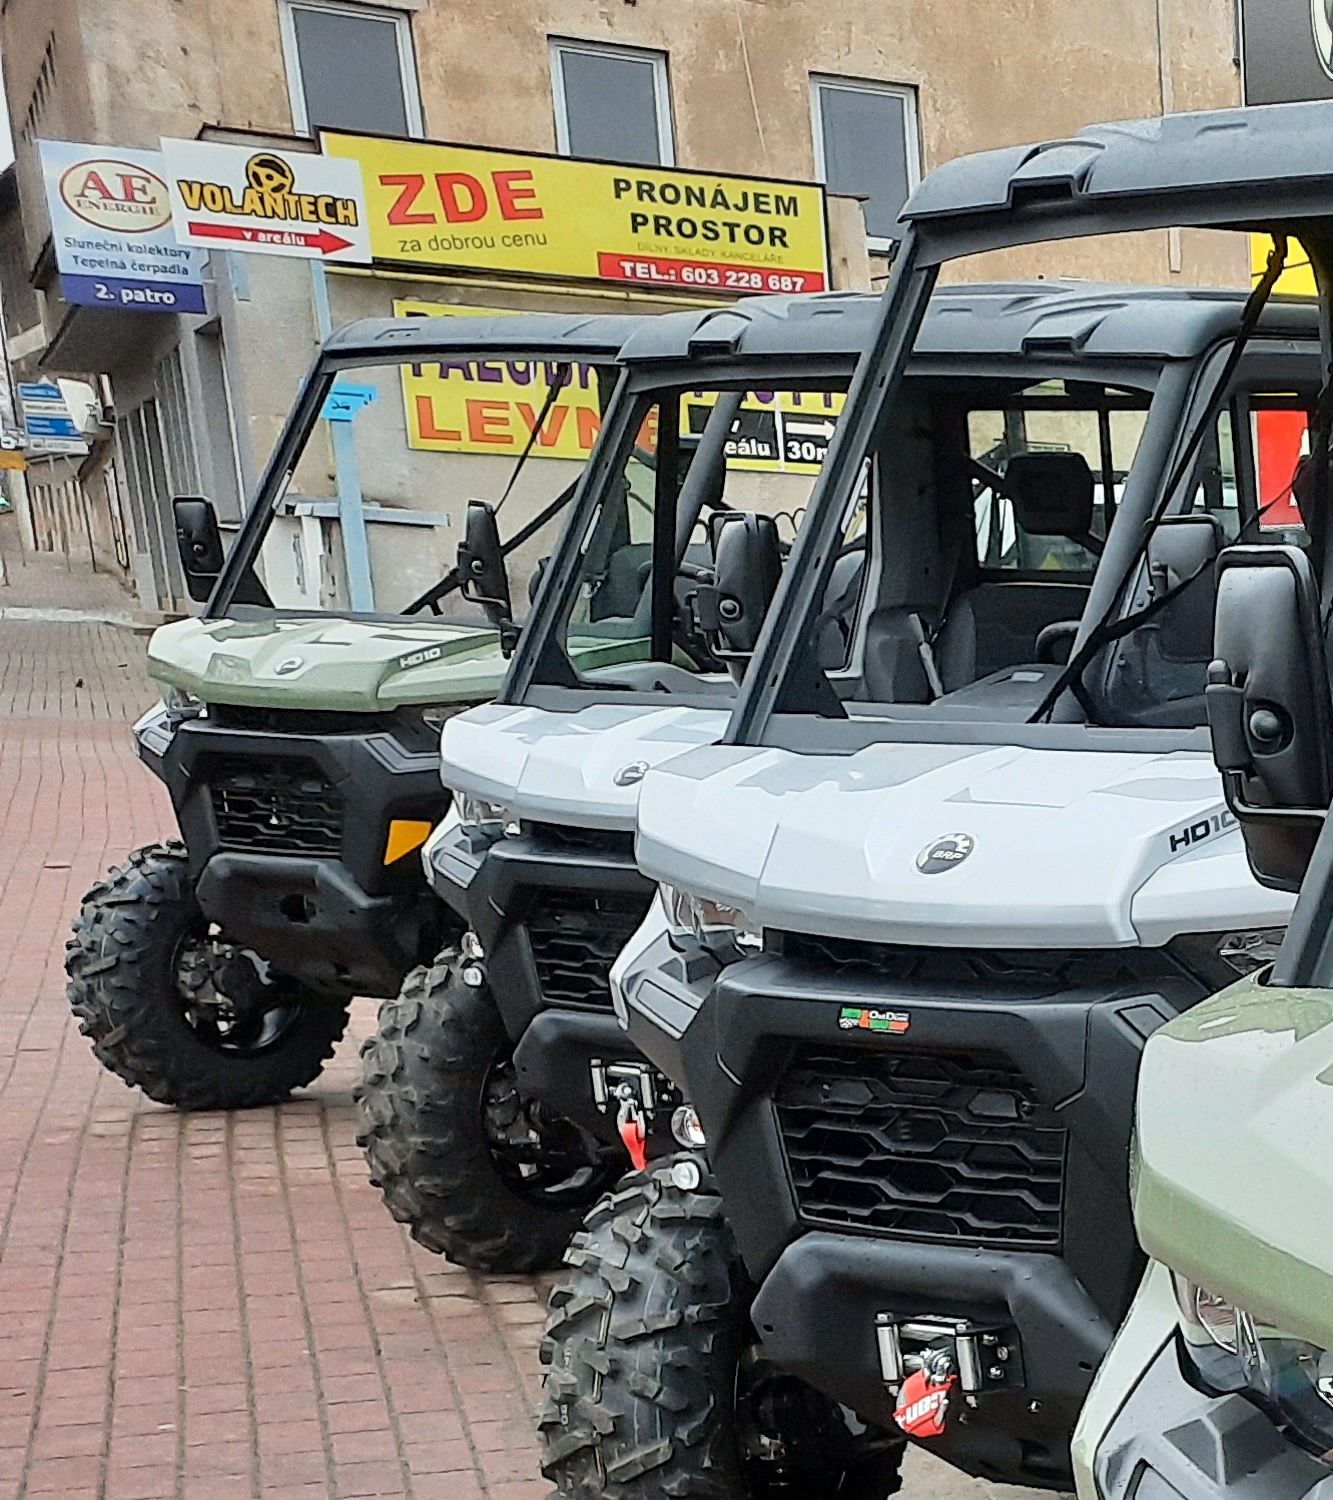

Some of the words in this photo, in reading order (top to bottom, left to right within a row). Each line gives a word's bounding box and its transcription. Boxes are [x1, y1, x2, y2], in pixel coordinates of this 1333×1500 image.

[74, 171, 156, 204] AE
[377, 169, 545, 226] ZDE
[613, 177, 799, 218] PRONÁJEM
[76, 199, 160, 216] ENERGIE
[177, 179, 359, 227] VOLANTECH
[242, 231, 253, 241] v
[257, 230, 306, 247] areálu
[399, 236, 422, 254] za
[428, 232, 495, 251] dobrou
[500, 231, 548, 248] cenu
[630, 212, 790, 249] PROSTOR
[64, 236, 123, 252] Sluneční
[126, 242, 191, 260] kolektory
[72, 254, 127, 270] Tepelná
[131, 259, 189, 276] čerpadla
[619, 260, 676, 281] TEL.:
[681, 266, 719, 285] 603
[725, 270, 762, 289] 228
[767, 275, 805, 292] 687
[94, 283, 115, 300] 2.
[122, 285, 176, 305] patro
[931, 849, 963, 861] BRP
